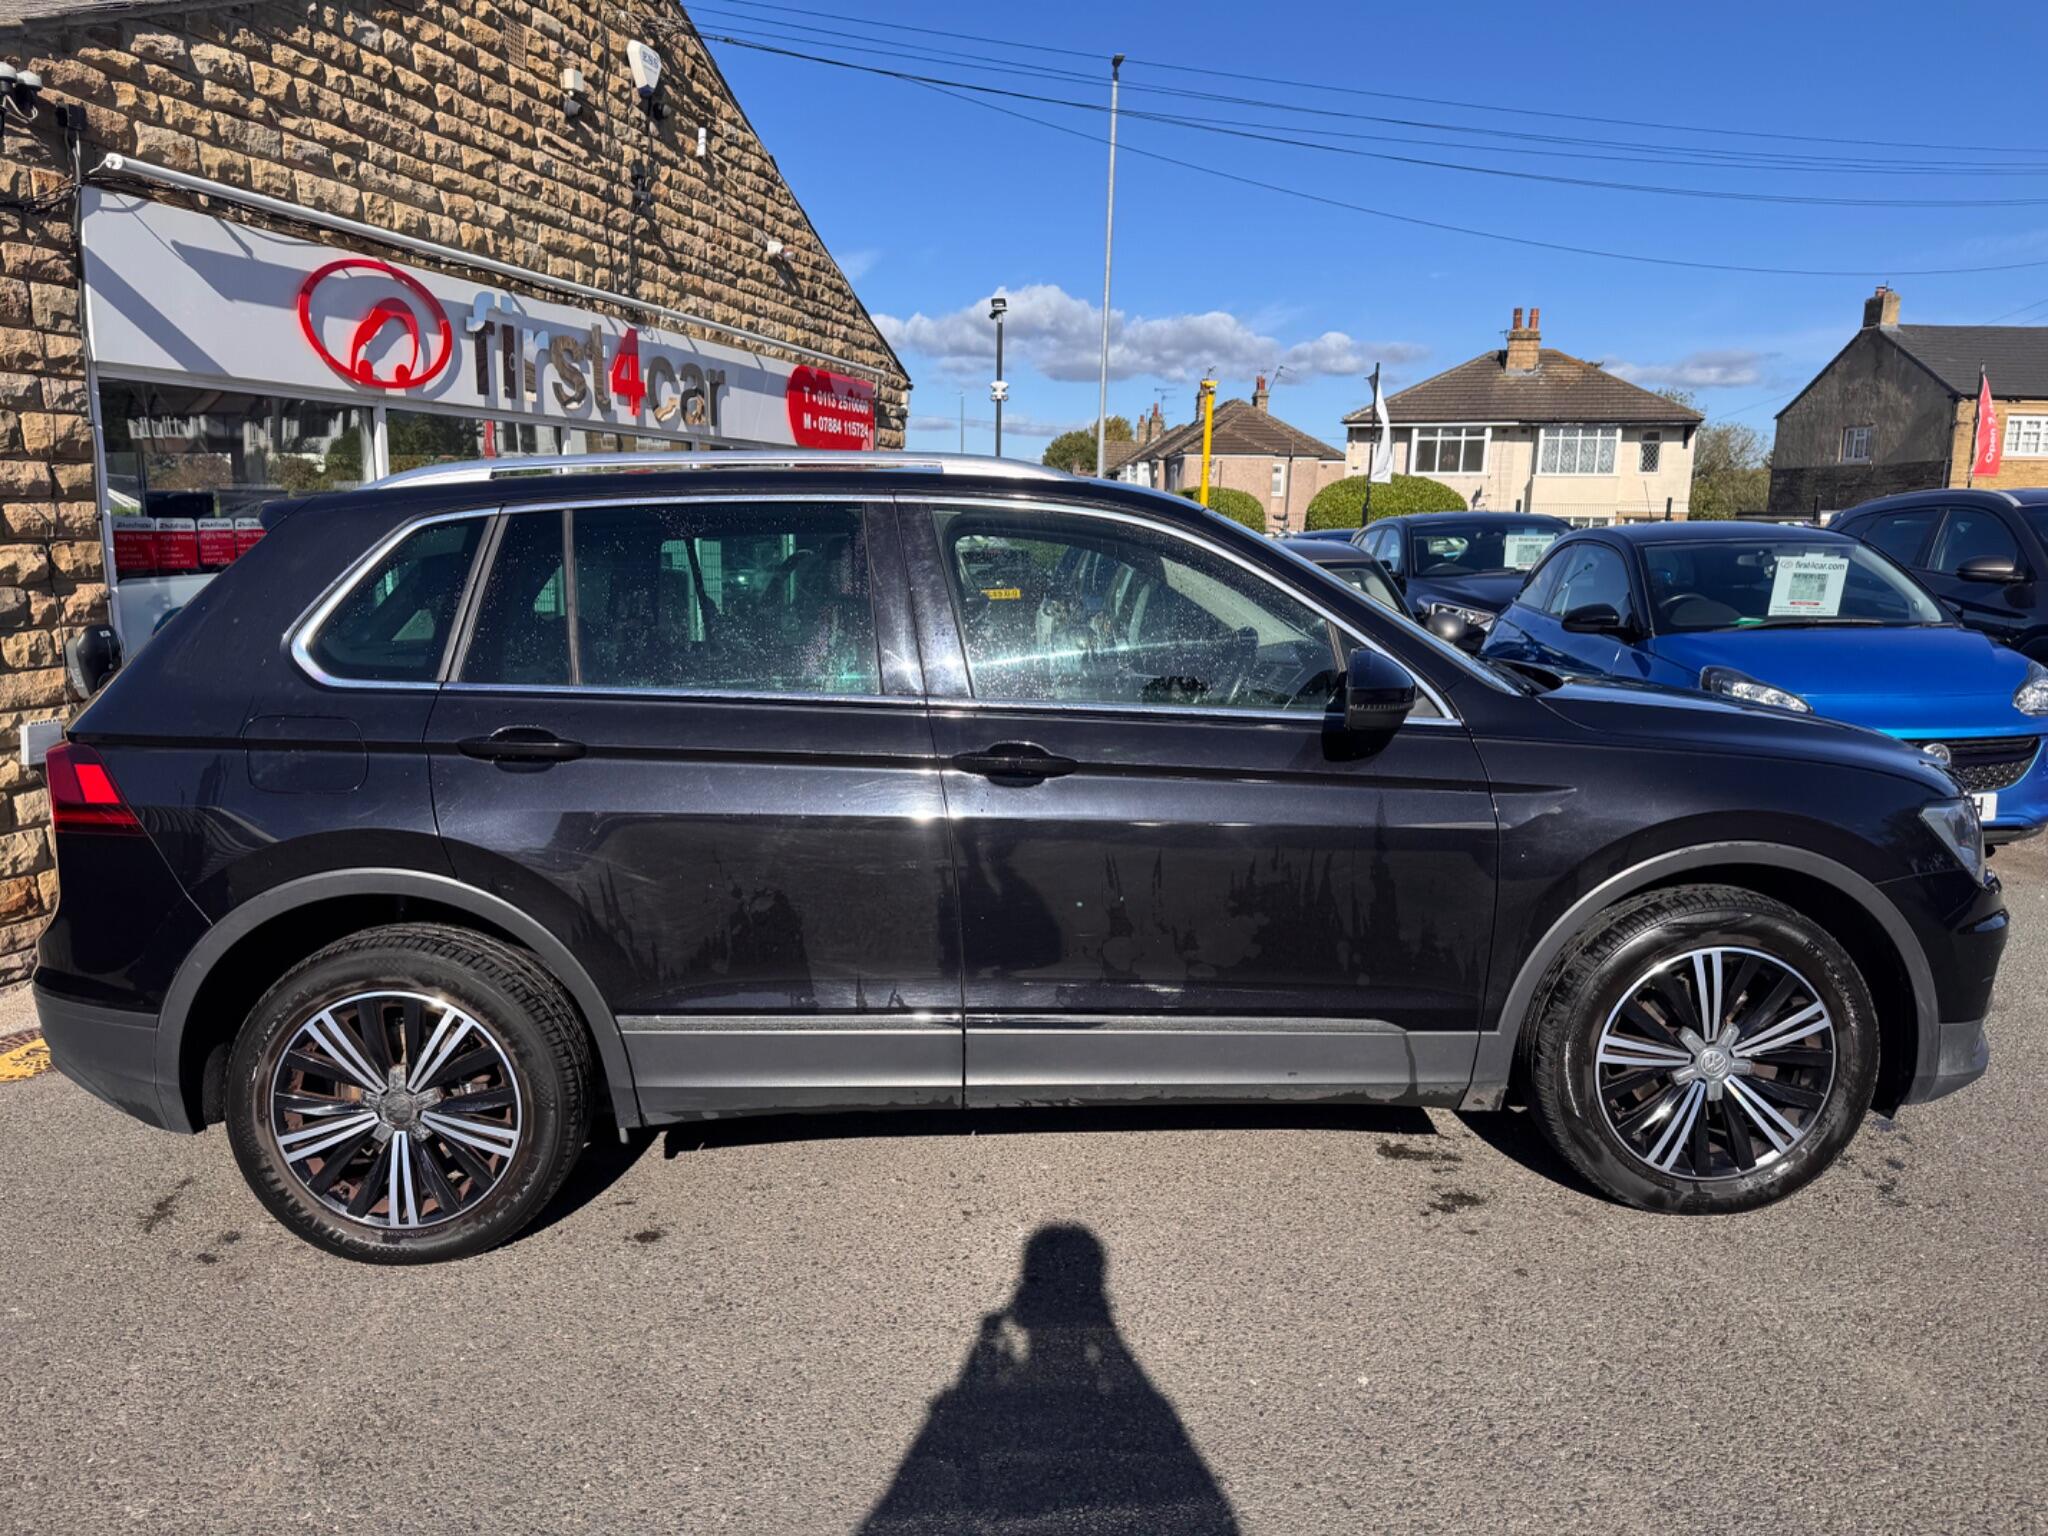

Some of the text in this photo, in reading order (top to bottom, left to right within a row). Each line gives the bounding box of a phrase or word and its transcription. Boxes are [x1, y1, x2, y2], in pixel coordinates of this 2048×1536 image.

[466, 291, 725, 427] first4car
[803, 386, 810, 403] T
[803, 413, 812, 430] M
[1985, 428, 1997, 463] Open
